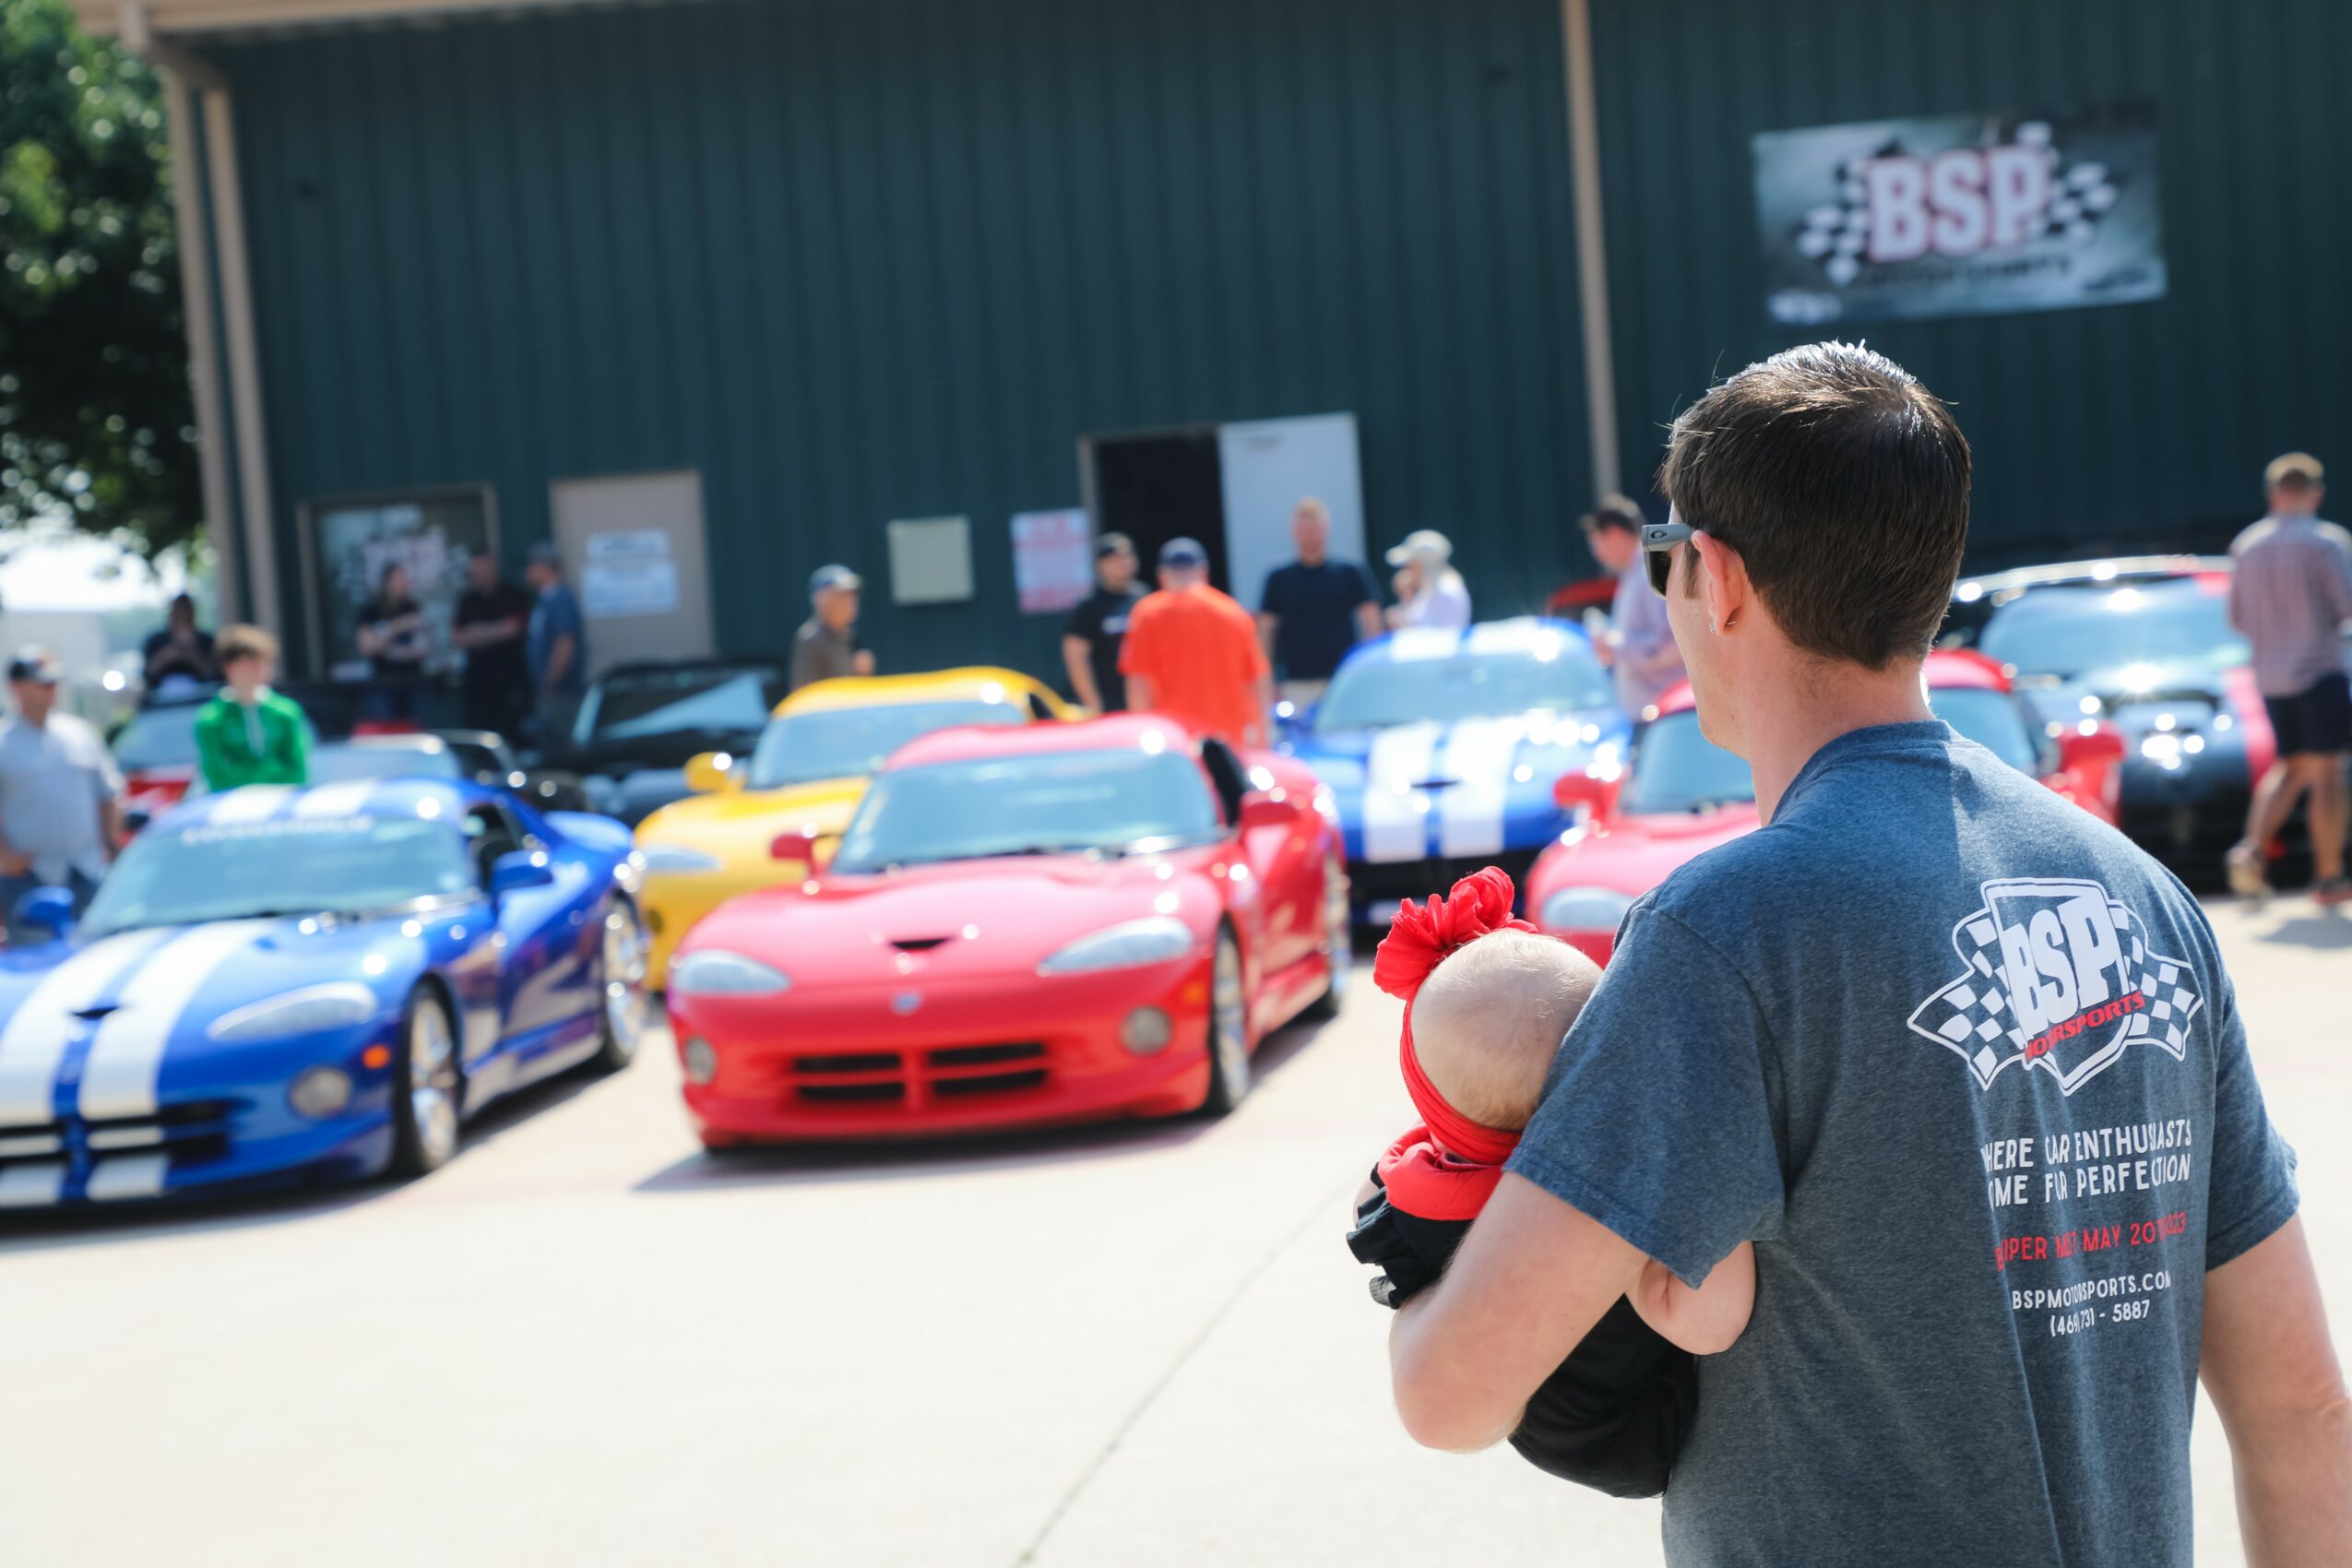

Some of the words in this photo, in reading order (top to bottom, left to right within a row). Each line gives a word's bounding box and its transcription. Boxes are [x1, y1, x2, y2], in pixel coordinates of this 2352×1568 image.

[1869, 145, 2049, 262] BSP
[2002, 893, 2121, 1038] BSP
[2045, 1134, 2070, 1165] CAR
[2074, 1118, 2192, 1162] ENTHUSIASTS
[2076, 1153, 2191, 1198] PERFECTION
[2083, 1225, 2121, 1253] MAY
[2112, 1299, 2150, 1322] 5887
